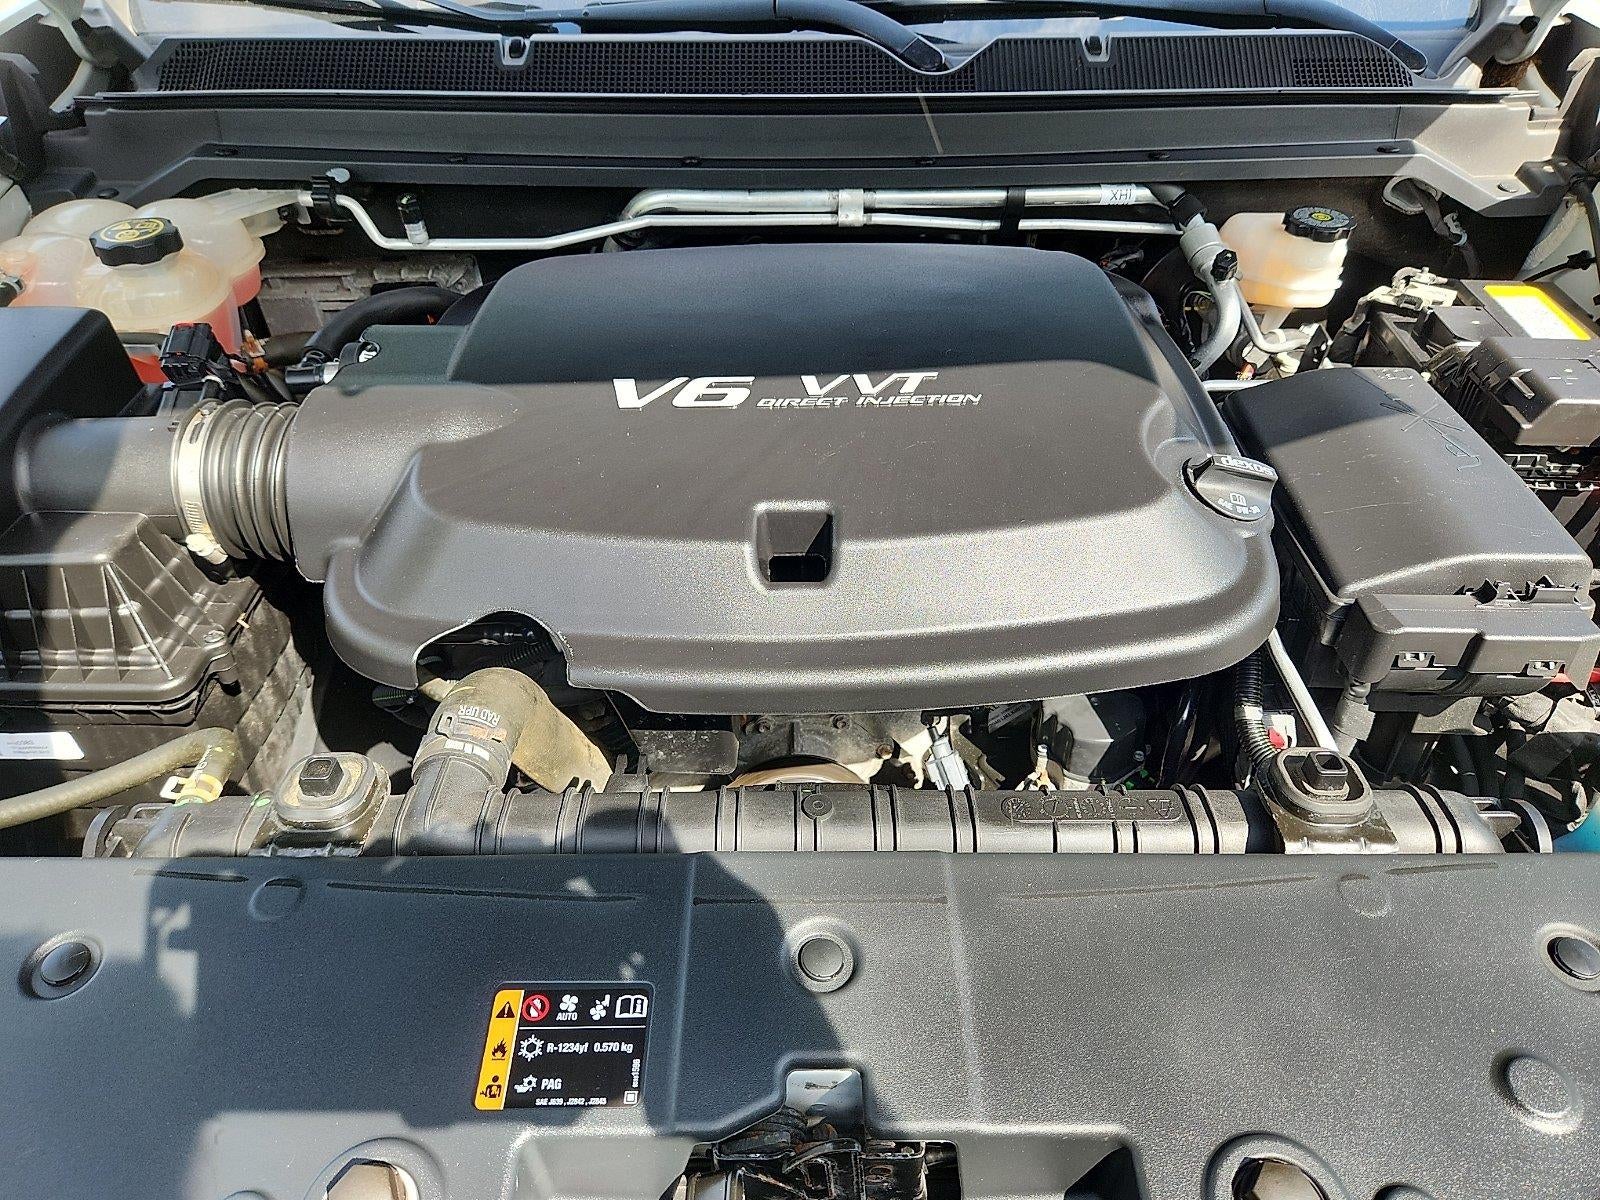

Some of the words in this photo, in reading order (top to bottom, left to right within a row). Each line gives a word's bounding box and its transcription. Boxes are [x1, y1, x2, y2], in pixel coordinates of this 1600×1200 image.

[613, 376, 755, 408] V6
[800, 372, 938, 396] VVT
[757, 396, 849, 408] DIRECT
[855, 393, 982, 408] INJECTION
[458, 704, 480, 718] UPR
[480, 708, 501, 726] RAD
[556, 1011, 578, 1021] AUTO
[546, 1042, 589, 1055] R-1234yf
[594, 1042, 619, 1053] 0.570
[621, 1042, 634, 1054] kg
[541, 1078, 562, 1090] PAG
[535, 1098, 548, 1106] SAE
